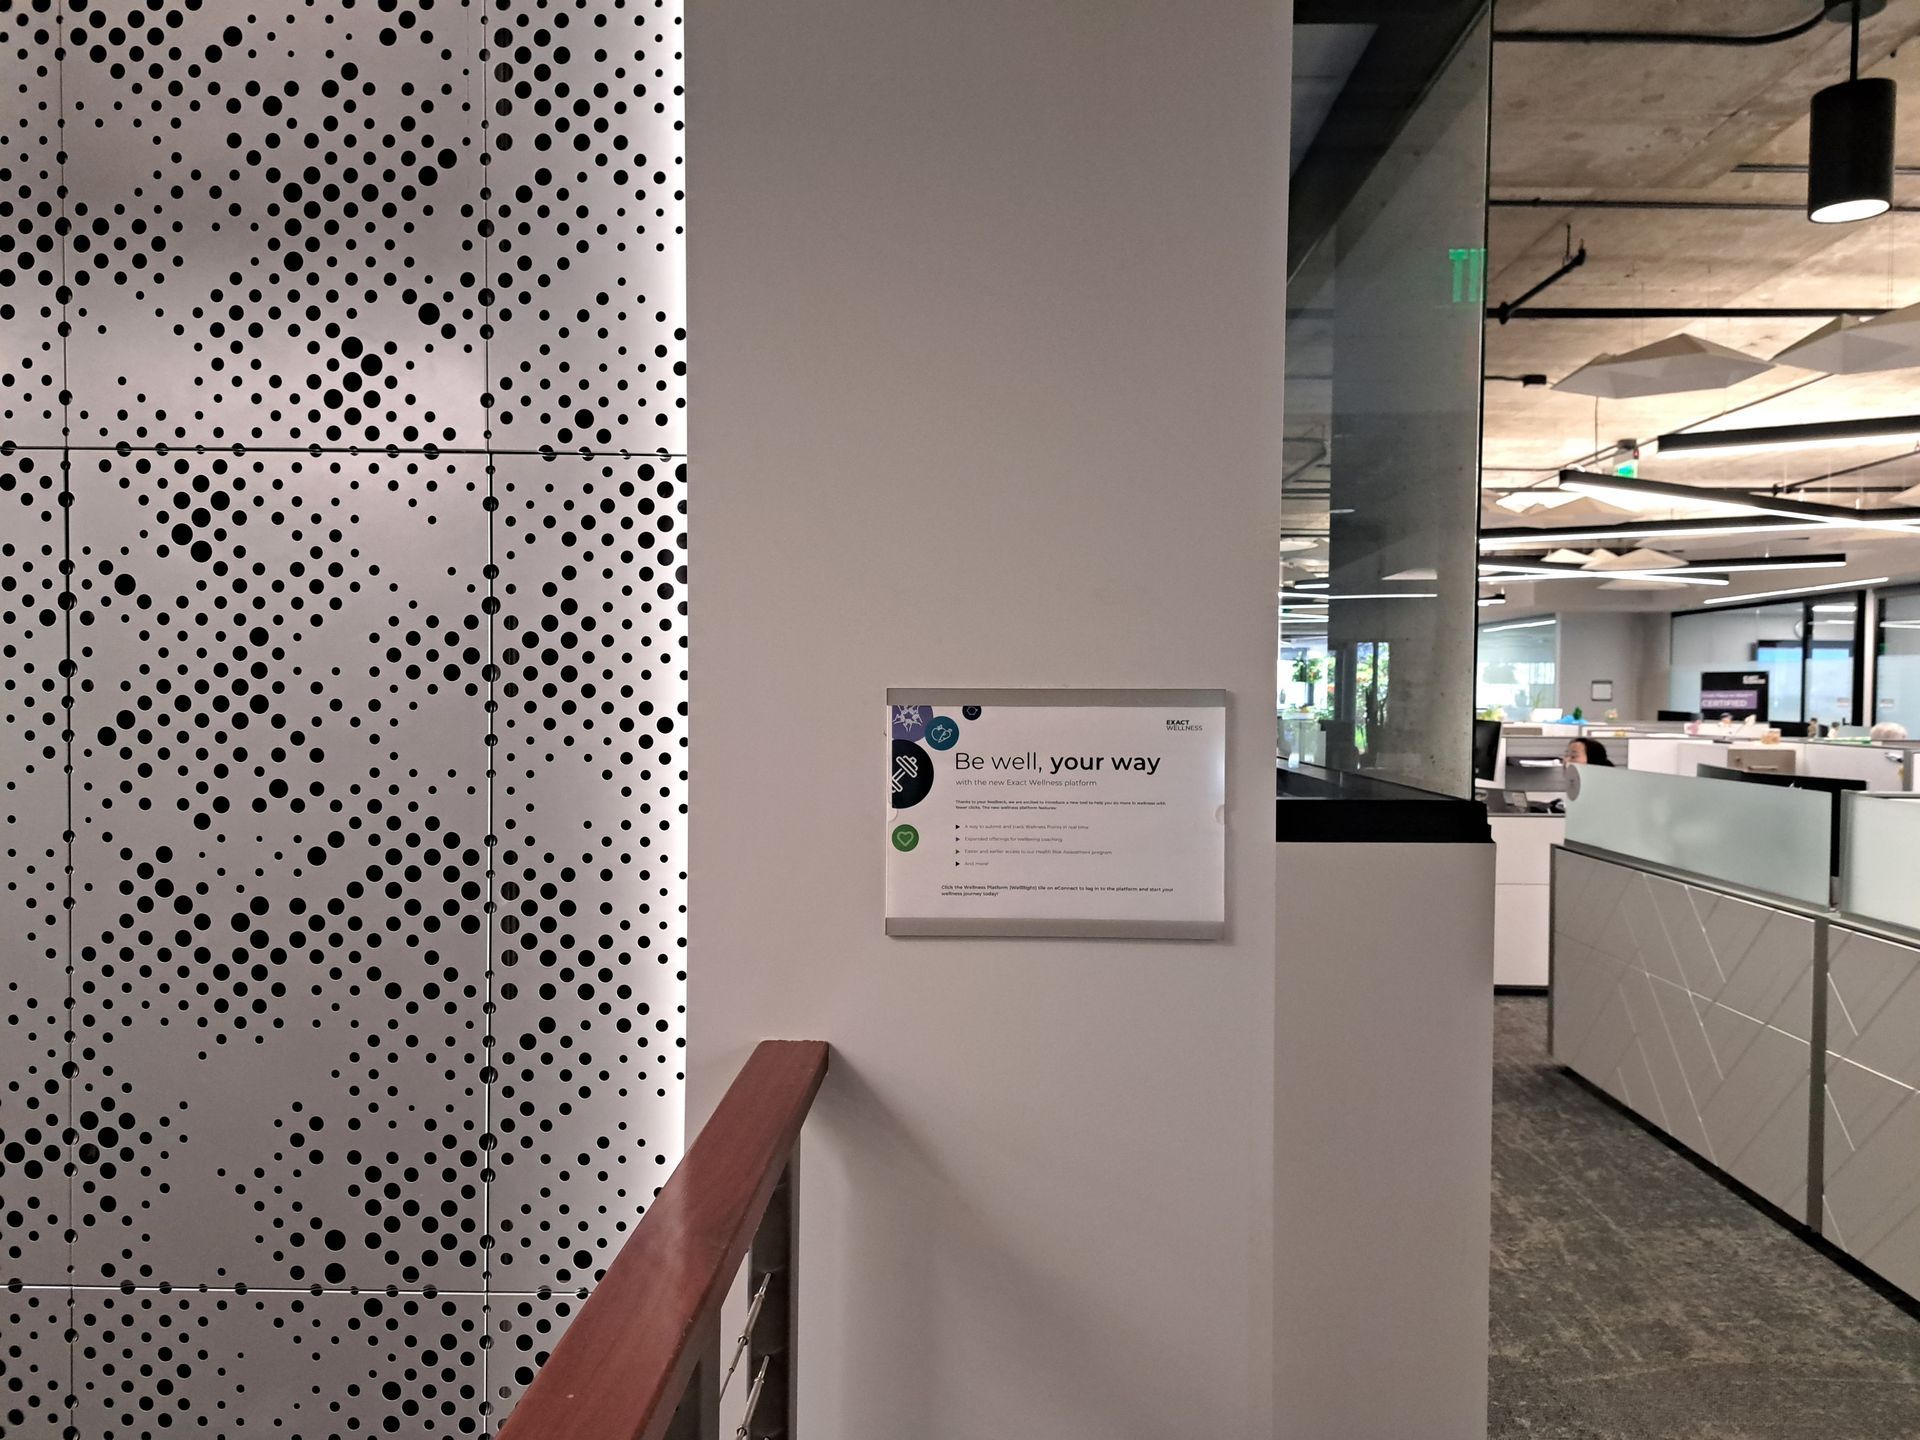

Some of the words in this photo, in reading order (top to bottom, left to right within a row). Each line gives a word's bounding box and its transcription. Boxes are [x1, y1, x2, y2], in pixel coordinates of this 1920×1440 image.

[955, 753, 984, 770] Be
[992, 752, 1042, 772] well,
[1050, 755, 1104, 774] your
[1111, 755, 1160, 774] way
